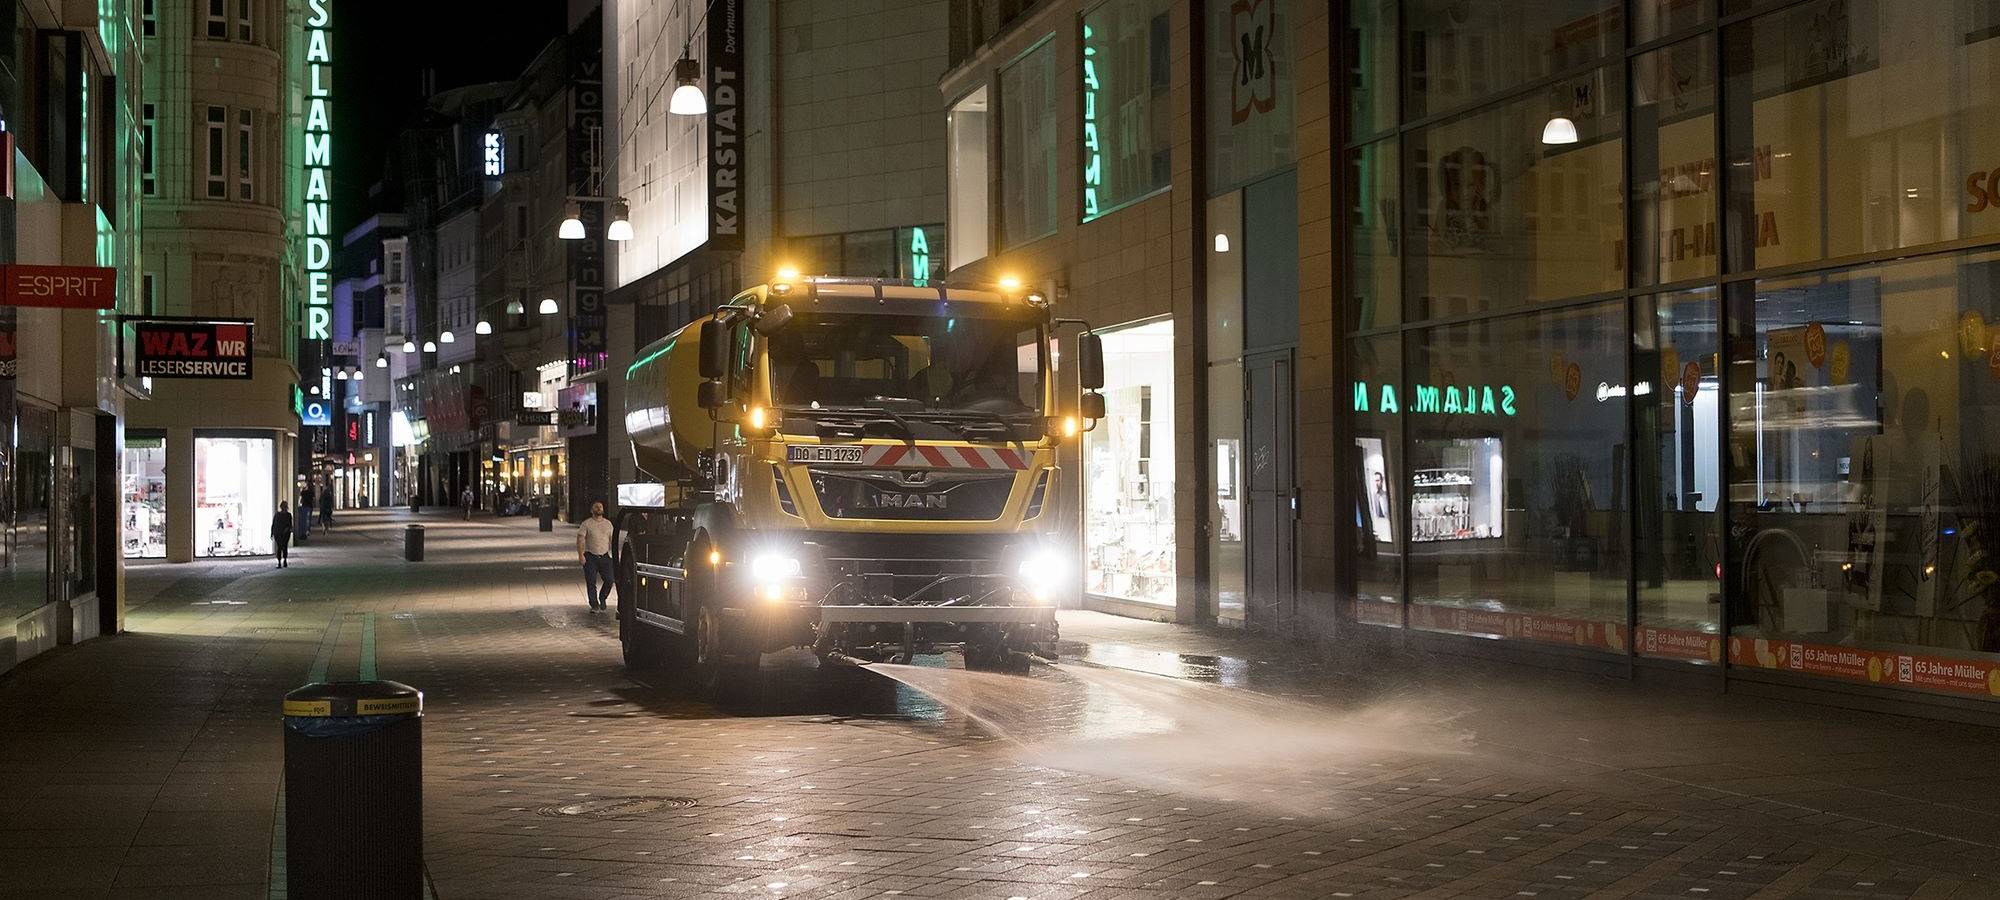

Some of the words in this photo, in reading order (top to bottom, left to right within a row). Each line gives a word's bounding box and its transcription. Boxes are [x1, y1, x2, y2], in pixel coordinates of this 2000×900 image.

[485, 133, 500, 176] KKH
[715, 66, 737, 236] KARSTADT
[305, 0, 330, 340] SALAMANDER
[19, 275, 103, 297] ESPRIT
[141, 333, 208, 357] WAZ
[216, 340, 246, 357] WR
[141, 360, 247, 376] LESERSERVICE
[817, 448, 832, 461] ED
[833, 448, 861, 462] 1739
[881, 493, 947, 508] MAN
[1805, 649, 1815, 661] 65
[1816, 650, 1838, 664] Jahre
[1839, 652, 1867, 667] Müller
[1915, 661, 1926, 673] 65
[1928, 662, 1953, 676] Jahre
[1955, 664, 1986, 680] Müller
